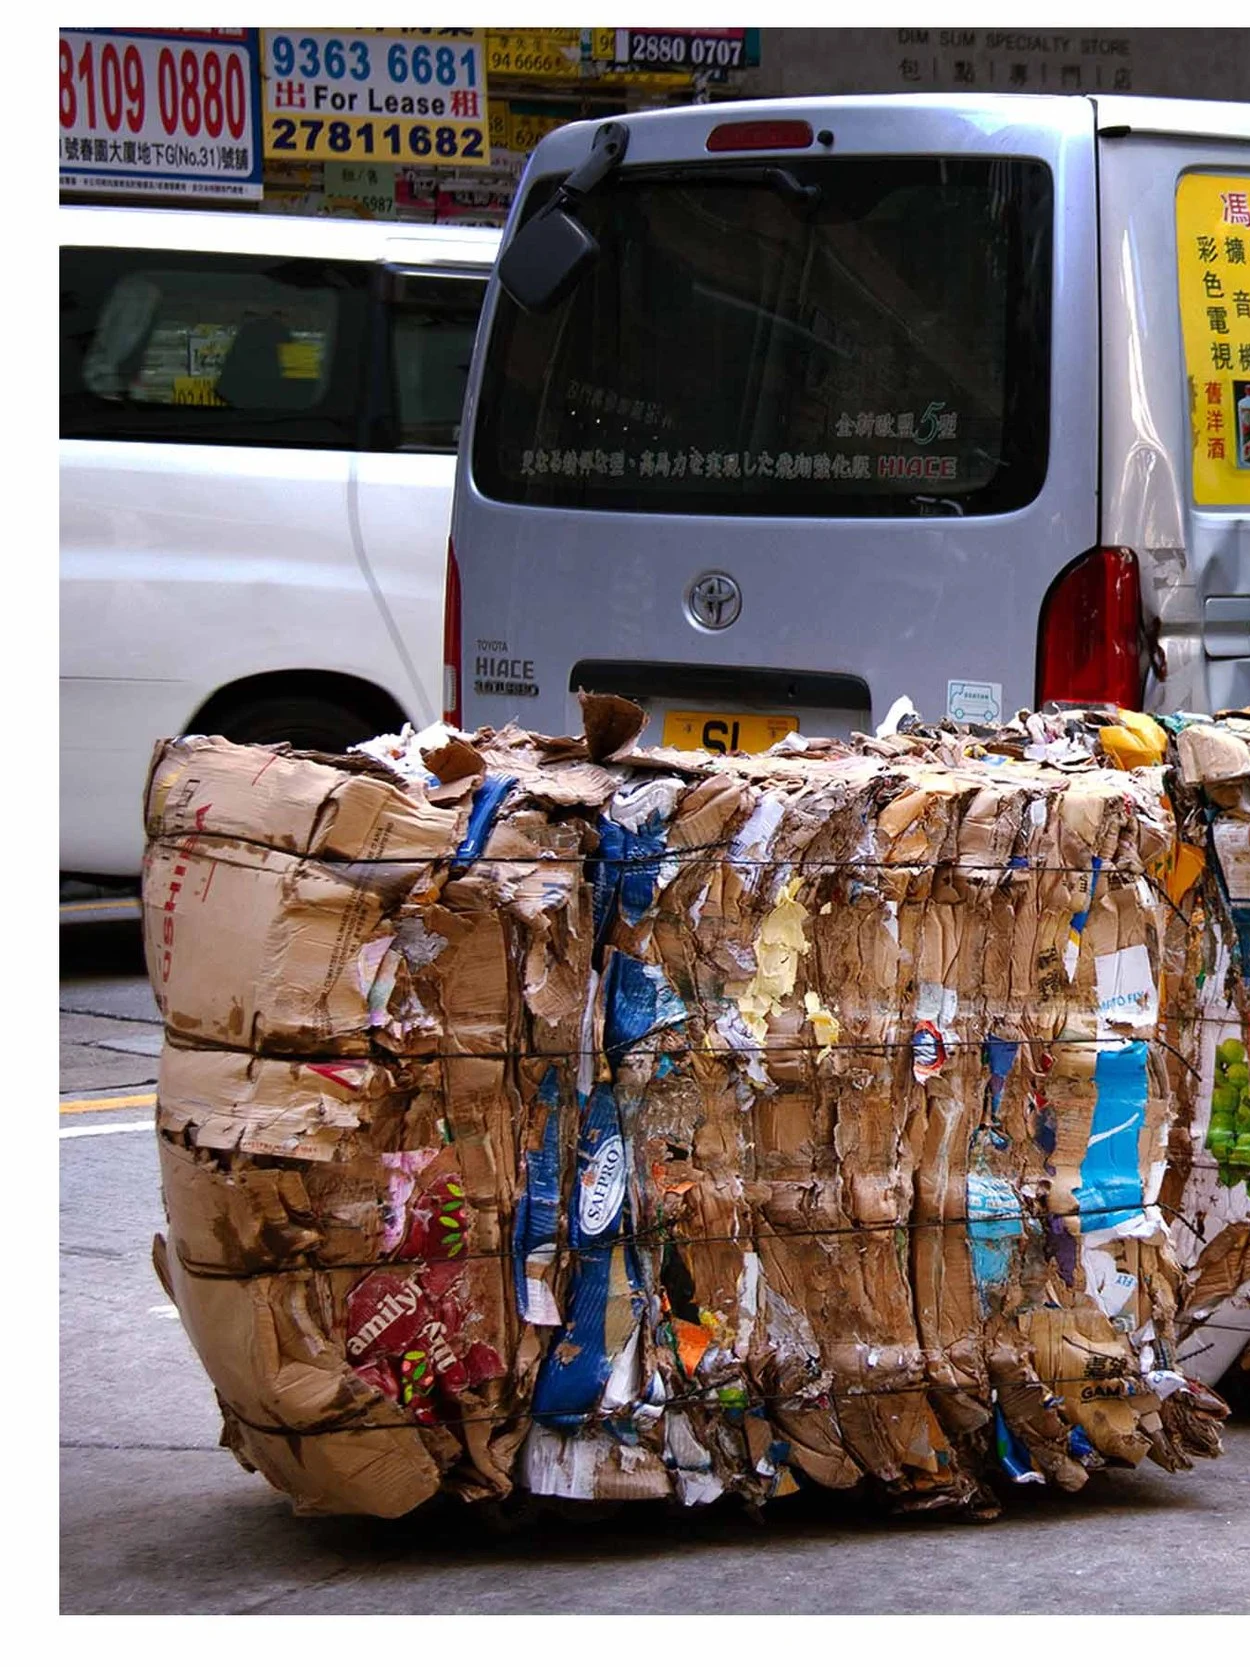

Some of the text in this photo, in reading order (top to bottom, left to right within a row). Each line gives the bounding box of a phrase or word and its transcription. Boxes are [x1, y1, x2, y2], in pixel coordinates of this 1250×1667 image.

[632, 36, 685, 62] 2880
[690, 38, 743, 66] 0707
[940, 31, 975, 47] SUM
[986, 33, 1069, 53] SPECIALTY
[1081, 38, 1131, 56] STORE
[272, 36, 477, 87] 9363 6681
[158, 46, 246, 140] 0880
[275, 81, 480, 118] 出 For Lease 租
[272, 118, 484, 158] 27811682
[877, 454, 959, 480] HIACE
[477, 639, 508, 652] TOYOTA
[475, 656, 535, 679] HIACE
